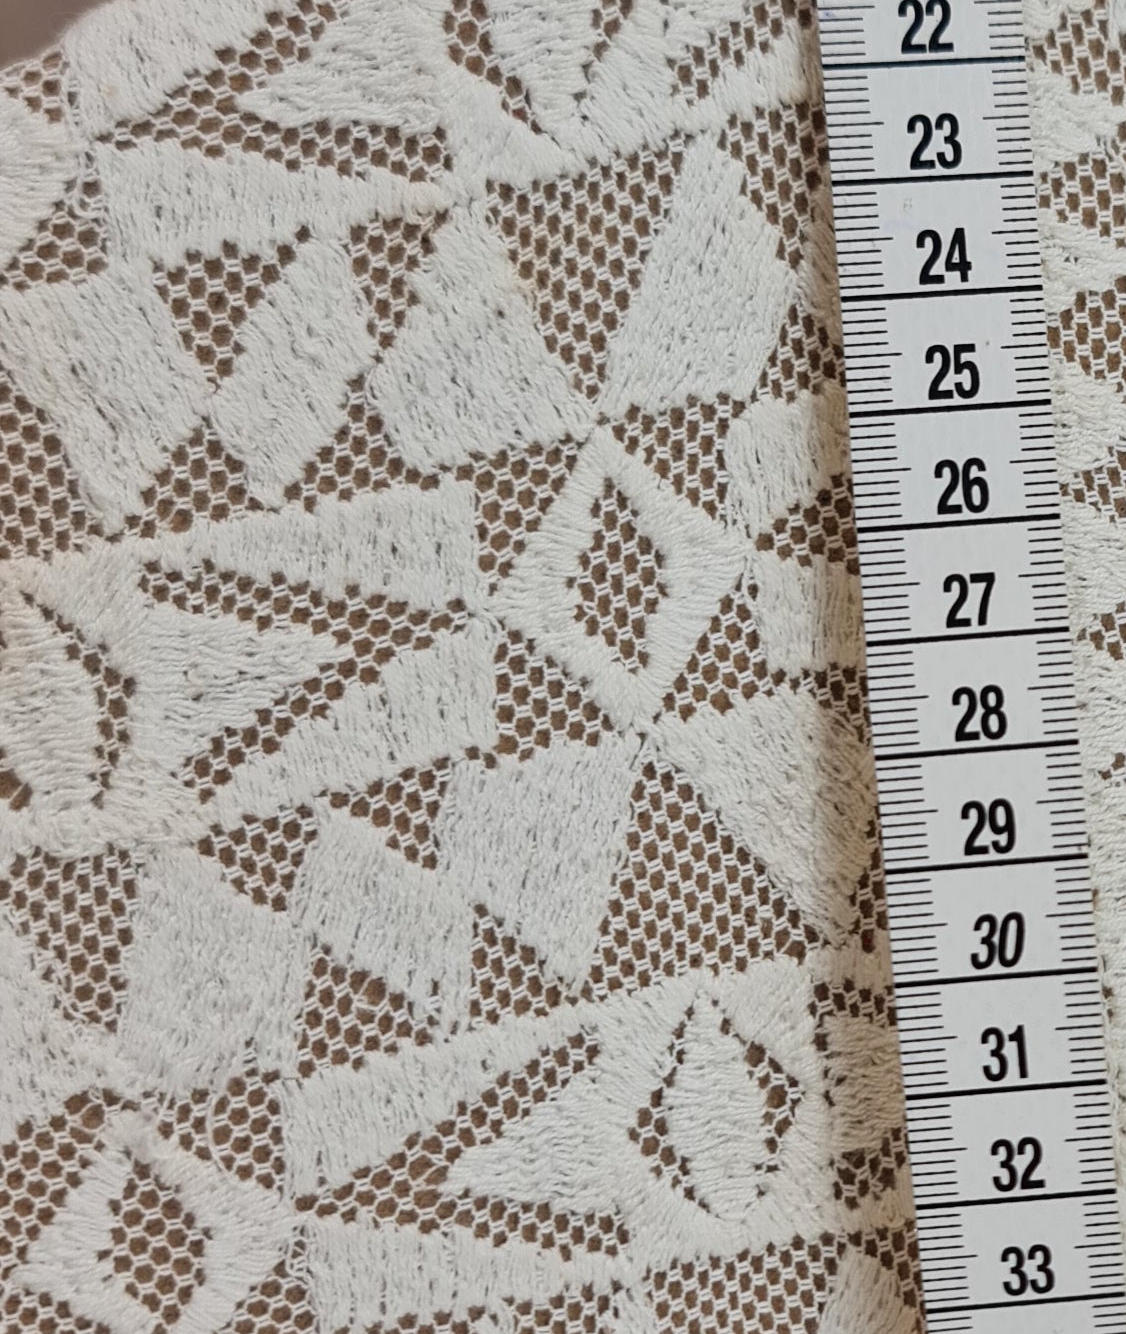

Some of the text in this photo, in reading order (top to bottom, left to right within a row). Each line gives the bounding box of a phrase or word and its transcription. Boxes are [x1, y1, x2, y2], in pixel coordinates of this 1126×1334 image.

[907, 113, 962, 170] 23
[917, 228, 972, 285] 24
[926, 344, 979, 400] 25
[934, 458, 989, 515] 26
[944, 572, 995, 628] 27
[952, 685, 1007, 742] 28
[961, 799, 1015, 856] 29
[971, 912, 1025, 969] 30
[981, 1025, 1028, 1081] 31
[991, 1137, 1045, 1192] 32
[1001, 1245, 1054, 1296] 33
